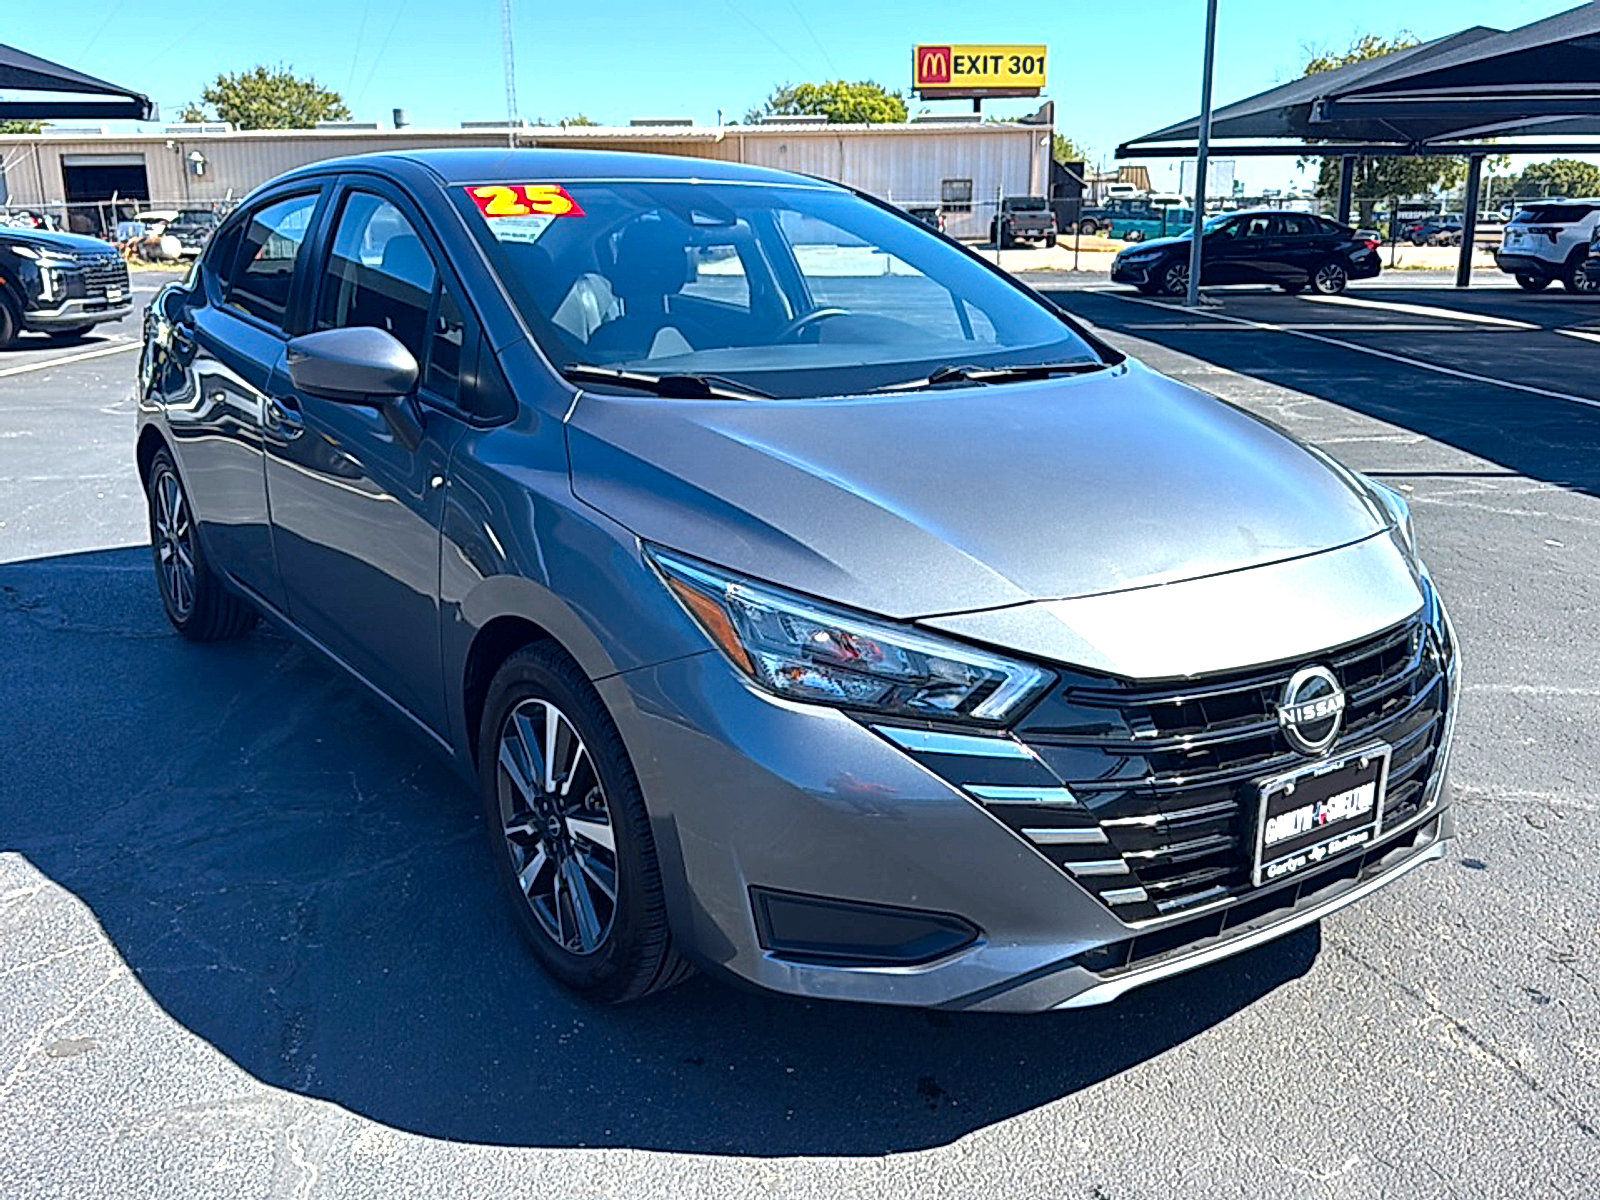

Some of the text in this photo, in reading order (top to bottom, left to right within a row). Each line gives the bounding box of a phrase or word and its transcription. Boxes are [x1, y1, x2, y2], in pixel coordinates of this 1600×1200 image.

[953, 55, 1045, 75] EXIT 301
[473, 185, 573, 215] 25
[1279, 693, 1345, 725] NISSAN
